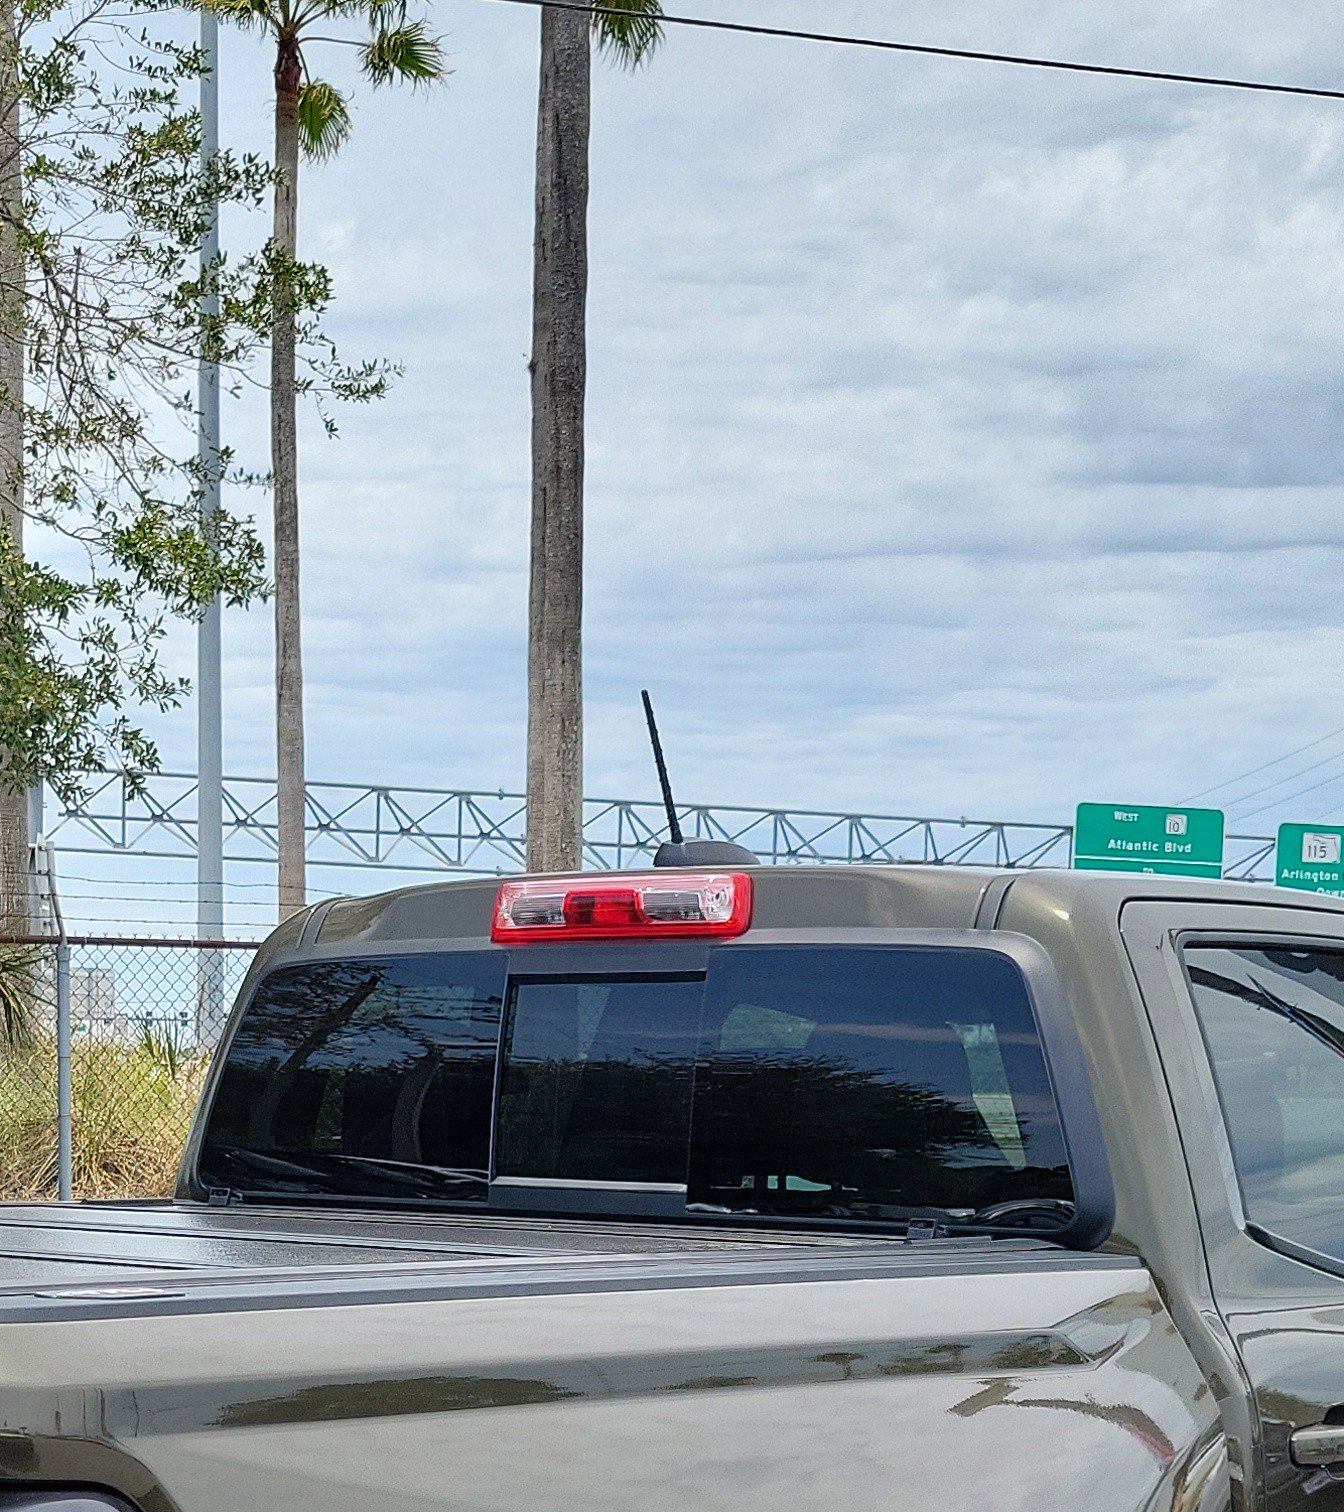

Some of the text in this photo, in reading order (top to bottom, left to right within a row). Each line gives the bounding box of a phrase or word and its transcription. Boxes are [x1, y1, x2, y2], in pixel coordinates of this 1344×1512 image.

[1113, 810, 1140, 822] WEST
[1168, 820, 1180, 833] 10
[1107, 838, 1192, 853] Atlantic Blvd
[1307, 845, 1327, 858] 115
[1281, 868, 1339, 883] Arlington
